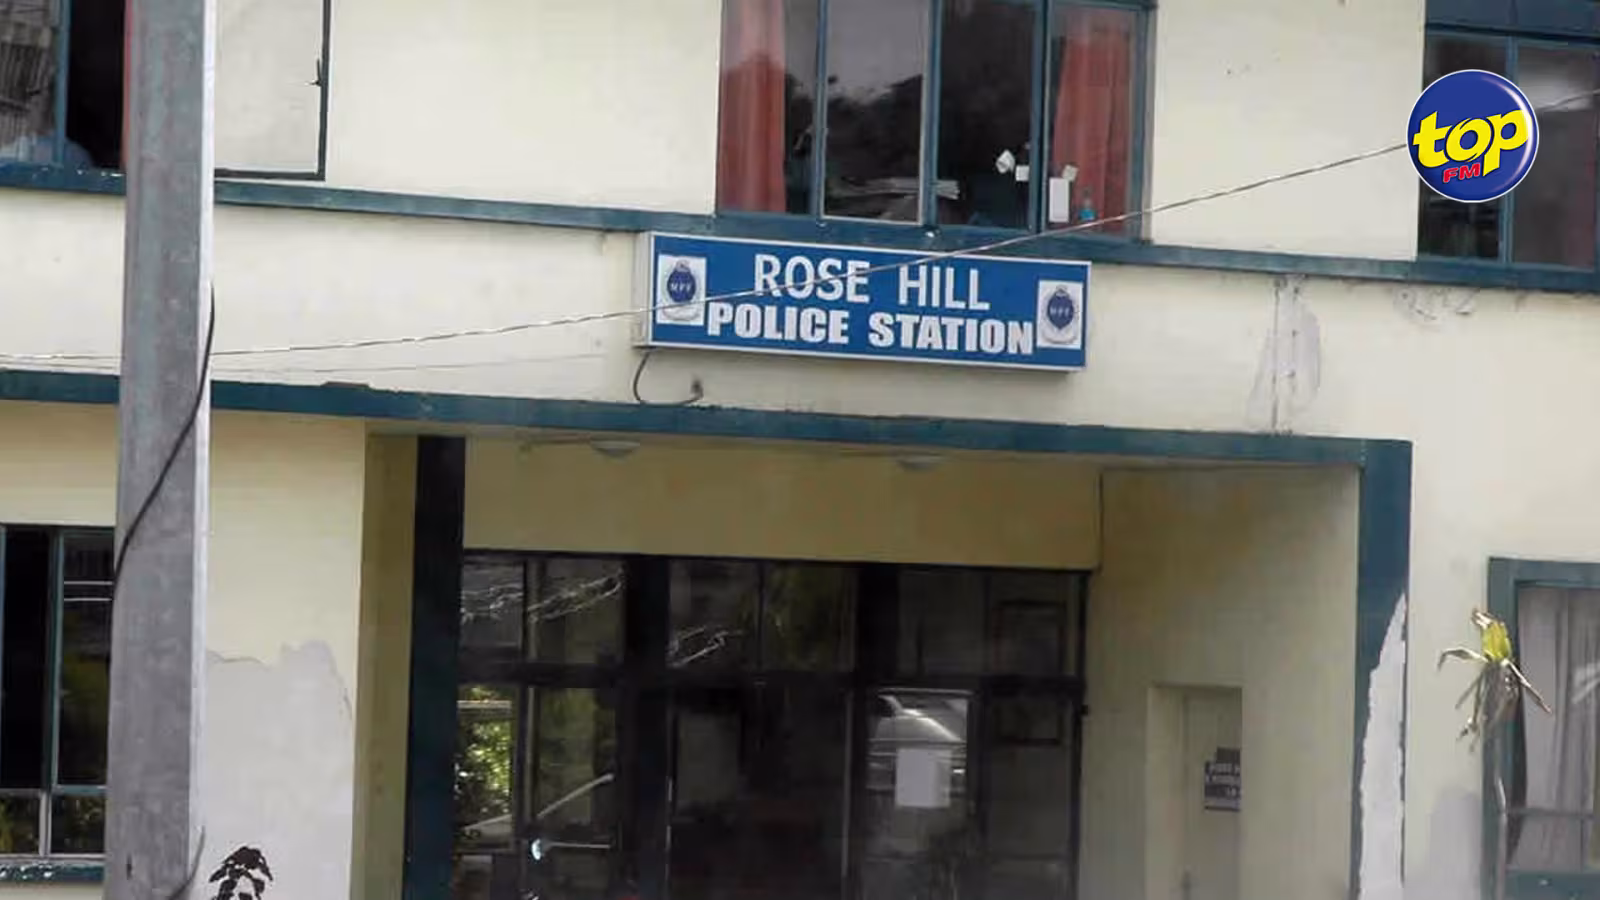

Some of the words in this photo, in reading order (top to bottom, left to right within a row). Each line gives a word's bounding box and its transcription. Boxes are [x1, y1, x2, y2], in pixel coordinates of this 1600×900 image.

[754, 254, 870, 304] ROSE
[899, 264, 991, 312] HILL
[706, 302, 850, 345] POLICE
[868, 312, 1034, 356] STATION
